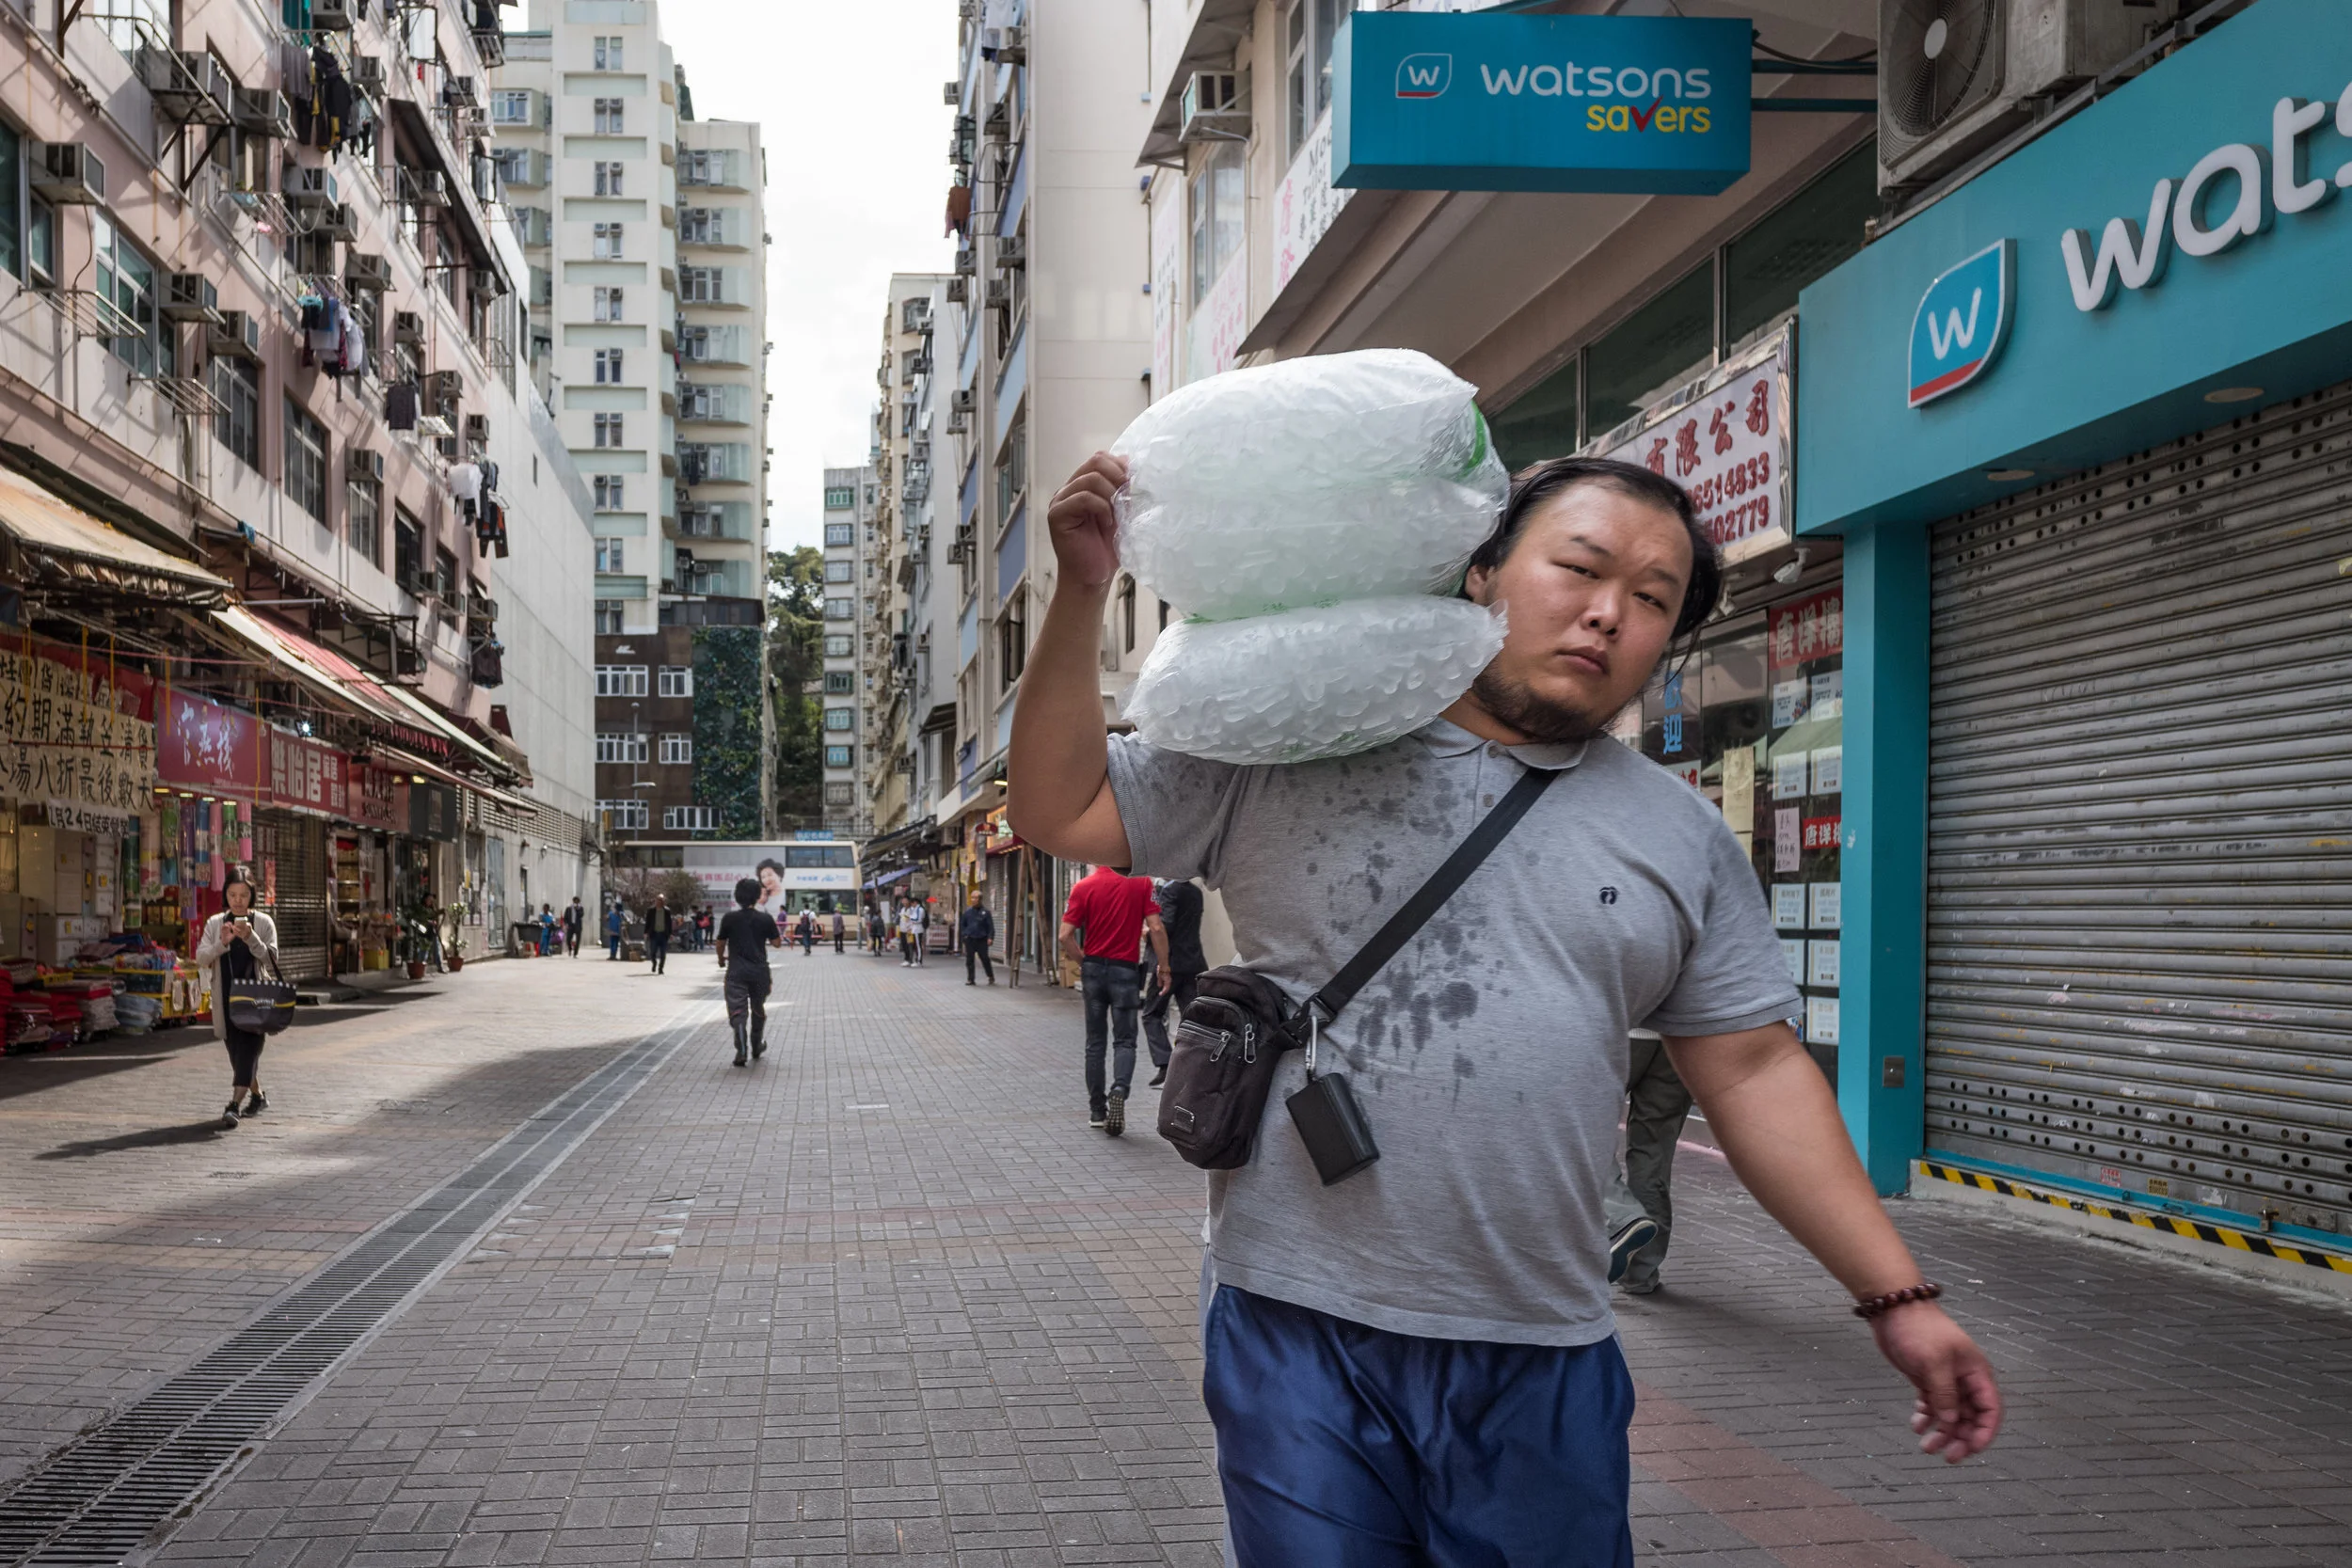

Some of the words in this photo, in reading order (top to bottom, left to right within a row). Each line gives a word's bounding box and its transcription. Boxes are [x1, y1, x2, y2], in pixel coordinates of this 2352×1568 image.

[1480, 61, 1711, 99] watsons
[1586, 95, 1711, 133] savers
[1645, 379, 1769, 477] 有限公司
[1686, 451, 1770, 515] 6514833
[0, 746, 154, 812] 場八折最後數天
